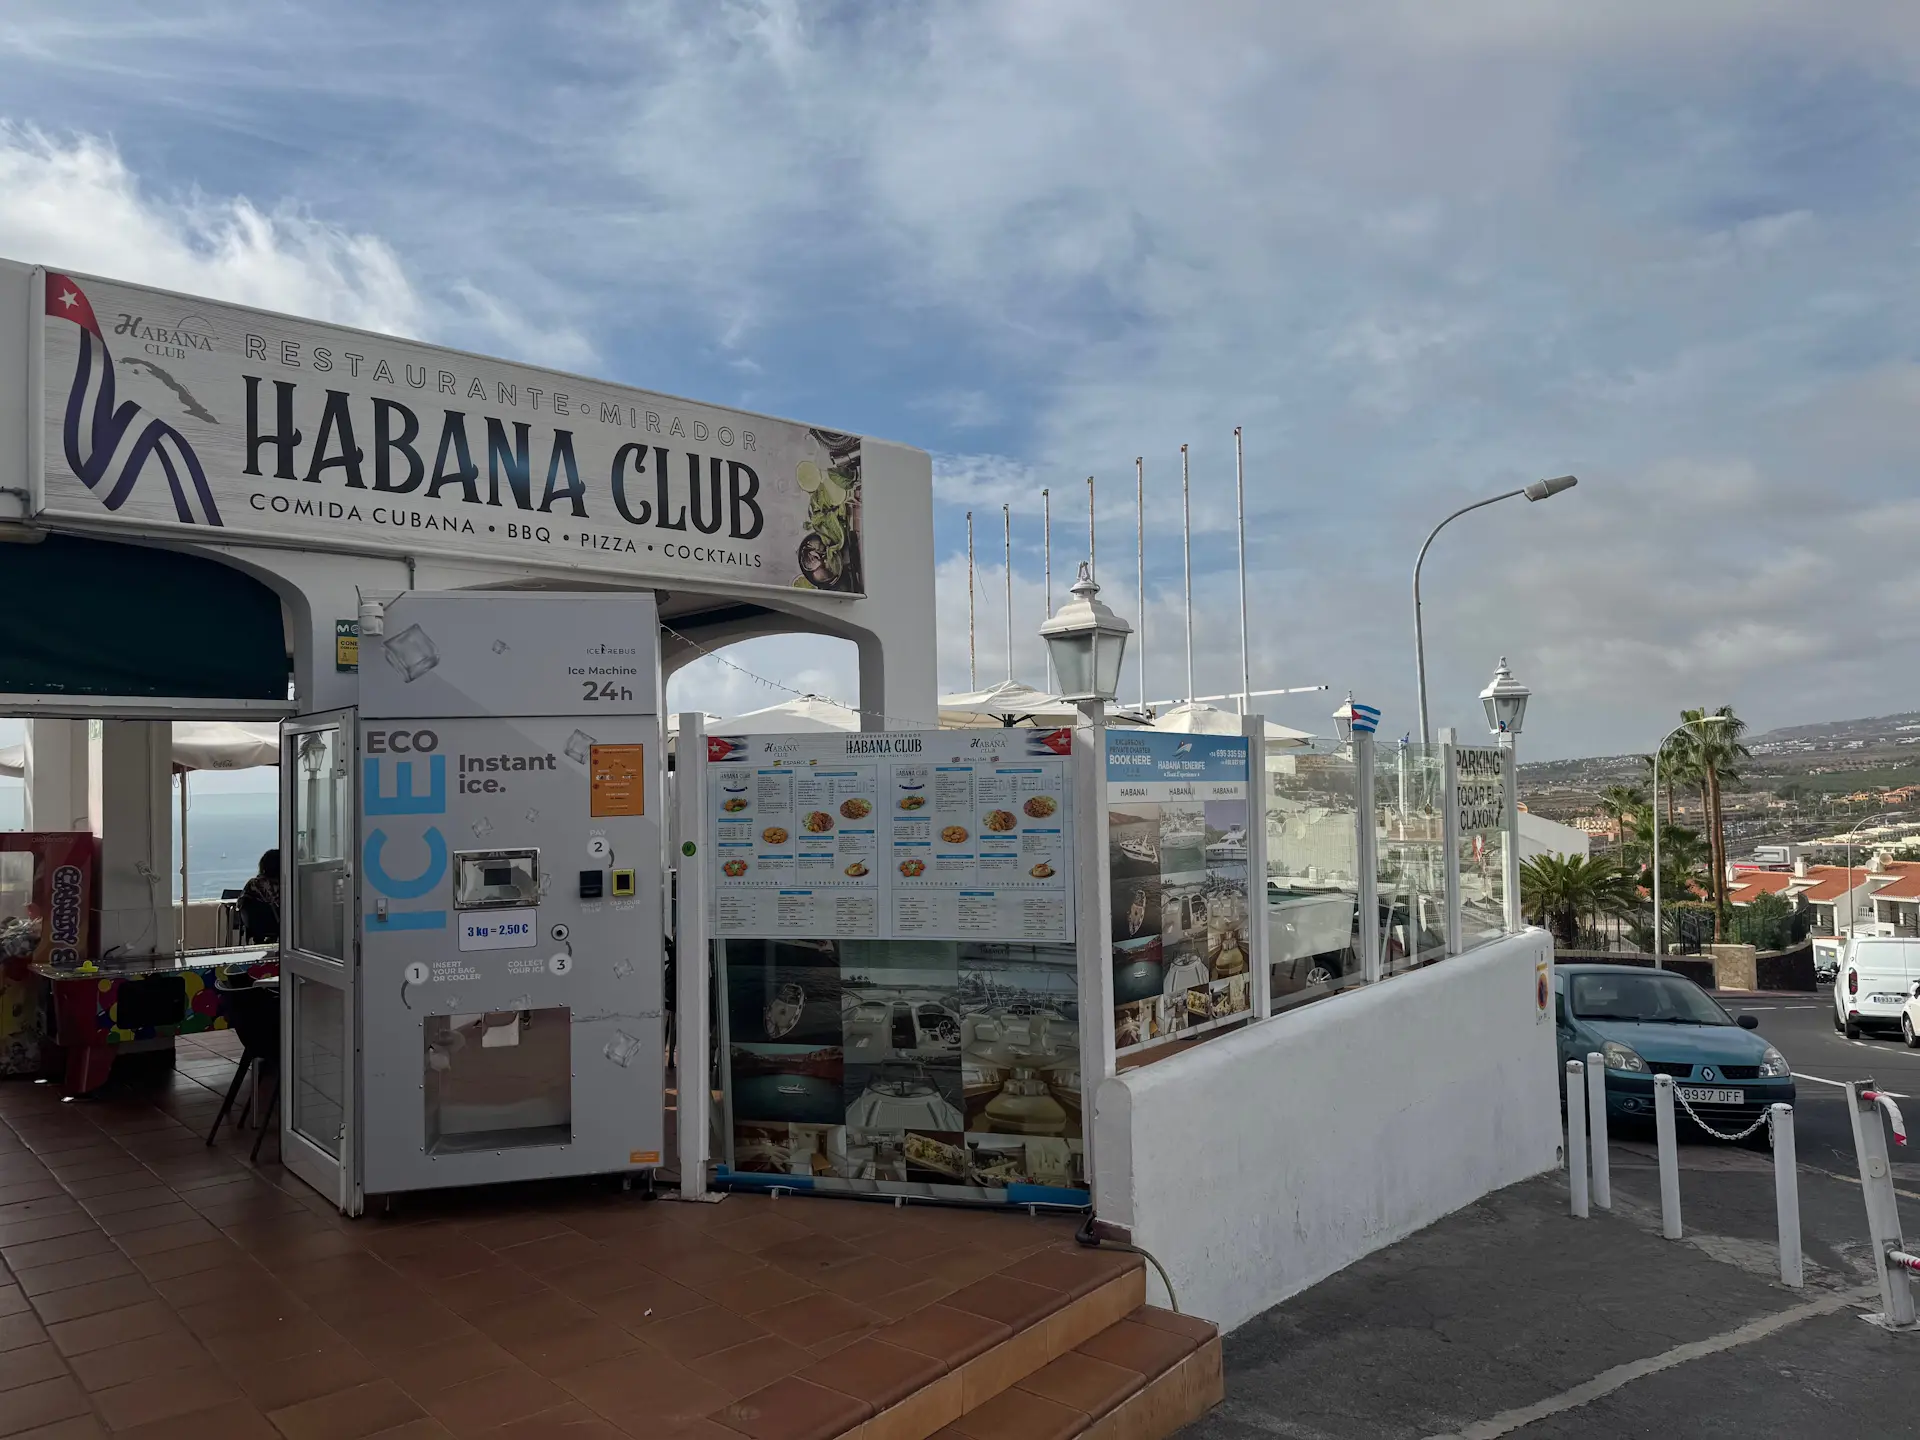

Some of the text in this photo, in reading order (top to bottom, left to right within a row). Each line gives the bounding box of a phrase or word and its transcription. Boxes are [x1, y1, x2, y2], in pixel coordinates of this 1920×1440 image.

[114, 313, 214, 352] HABANA
[144, 343, 186, 360] CLUB
[245, 334, 757, 452] RESTAURANTE MIRADOR
[242, 375, 764, 540] HABANA CLUB
[249, 493, 762, 569] COMIDA CUBANA BBQ PIZZA COCKTAILS
[568, 665, 637, 675] Ice Machine
[582, 681, 633, 701] 24h
[366, 730, 439, 753] ECO
[764, 742, 798, 753] HABANA
[845, 738, 923, 754] HABANA CLUB
[970, 738, 1006, 748] HABANA
[459, 753, 557, 772] Instant
[1109, 754, 1151, 765] BOOK HERE
[1157, 760, 1206, 770] HABANA TENERIFE
[1456, 749, 1500, 776] PARKING
[459, 773, 507, 794] ice.
[1212, 787, 1233, 795] HABANA
[1120, 788, 1145, 797] HABANA
[1168, 787, 1191, 796] HABANA
[1456, 785, 1497, 806] TOCAR EL
[1460, 808, 1494, 830] CLAXON
[363, 755, 448, 932] ICE
[594, 841, 603, 852] 2
[51, 865, 82, 946] CANDY
[467, 926, 474, 937] 3
[476, 926, 489, 937] kg
[521, 923, 529, 934] €
[433, 967, 457, 975] YOUR
[508, 966, 531, 974] YOUR
[556, 959, 565, 970] 3
[413, 967, 420, 979] 1
[1683, 1089, 1741, 1102] 8937 DFF
